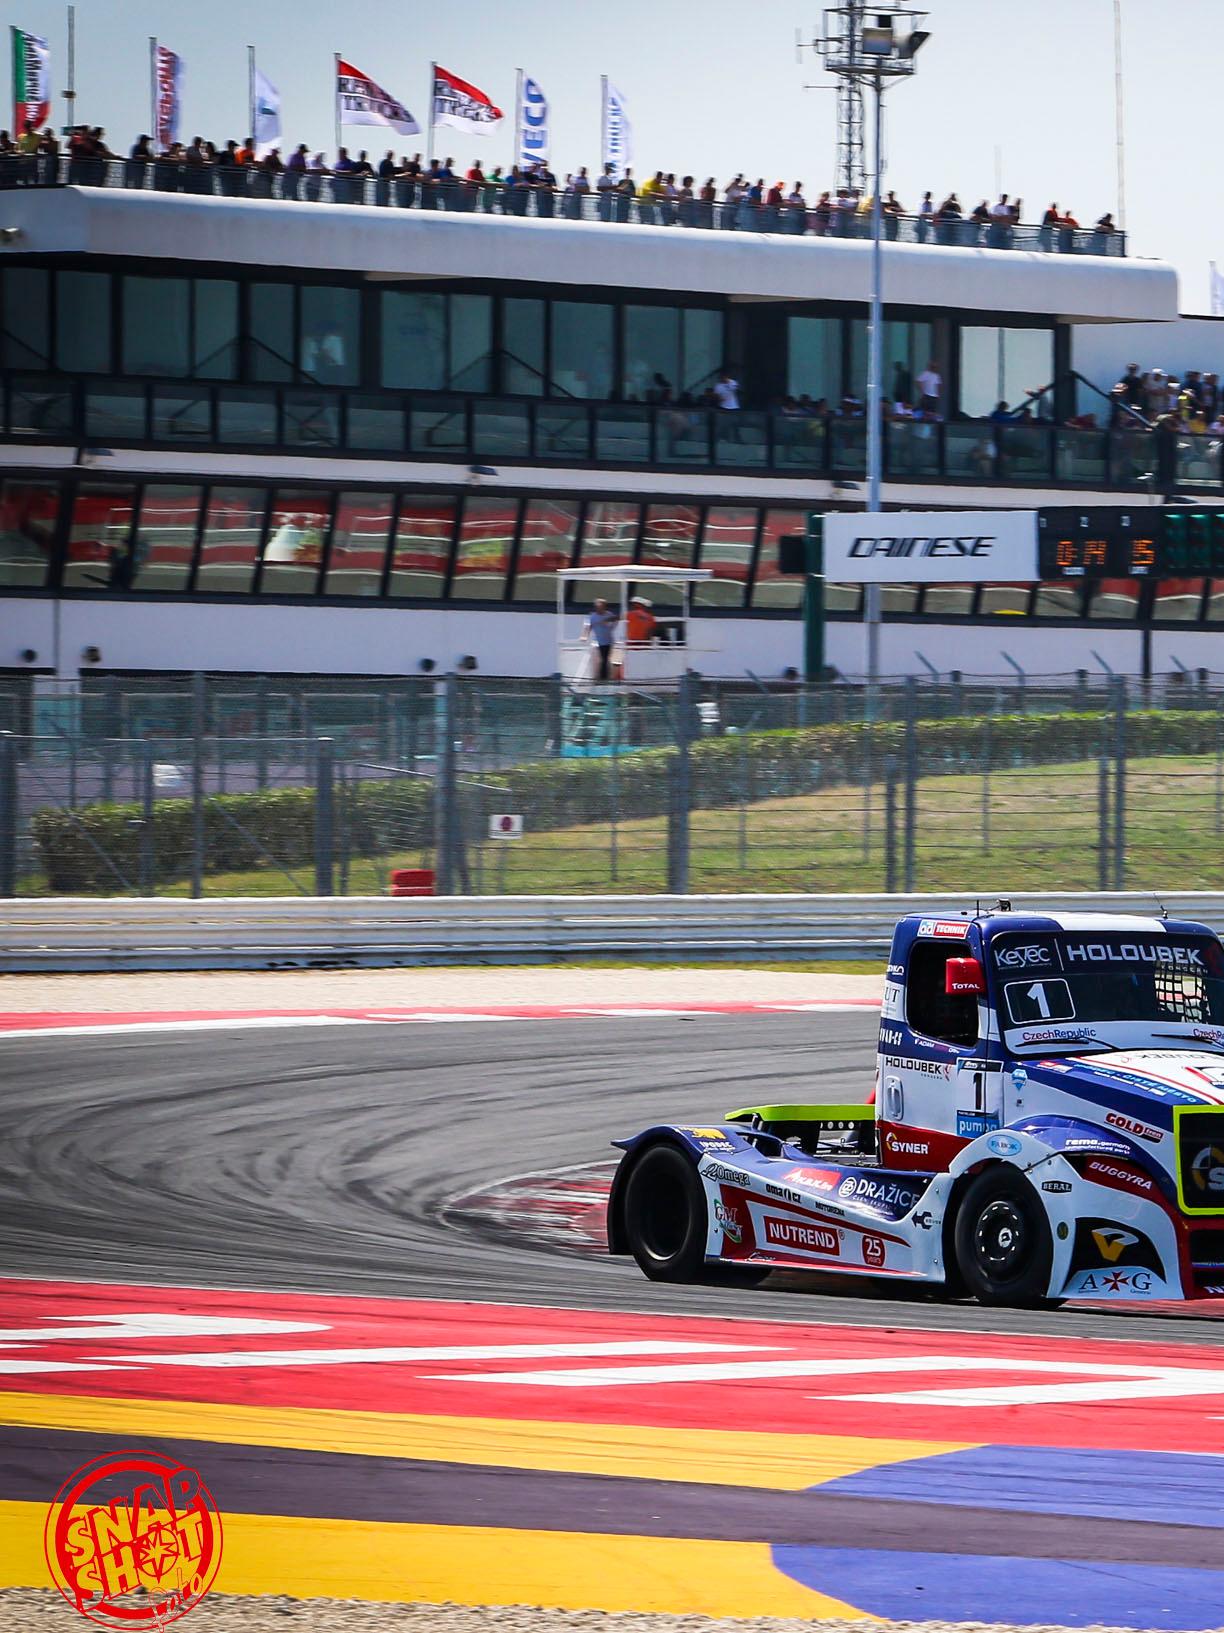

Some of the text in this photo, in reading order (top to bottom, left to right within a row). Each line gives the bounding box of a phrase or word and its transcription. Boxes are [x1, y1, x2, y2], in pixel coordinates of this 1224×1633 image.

[847, 536, 997, 558] DAINESE
[935, 925, 968, 935] TECHNIK
[1067, 944, 1205, 965] HOLOUBEK
[951, 982, 981, 990] TOTAL
[1026, 983, 1051, 1018] 1
[1022, 1027, 1097, 1041] CzechRepublic
[885, 1057, 942, 1075] HOLOUBEK
[973, 1072, 983, 1111] 1
[891, 1141, 929, 1154] SYNER
[1089, 1161, 1153, 1190] BUGGYRA
[1043, 1182, 1071, 1191] BERAL
[769, 1222, 836, 1249] NUTREND
[865, 1238, 881, 1257] 25
